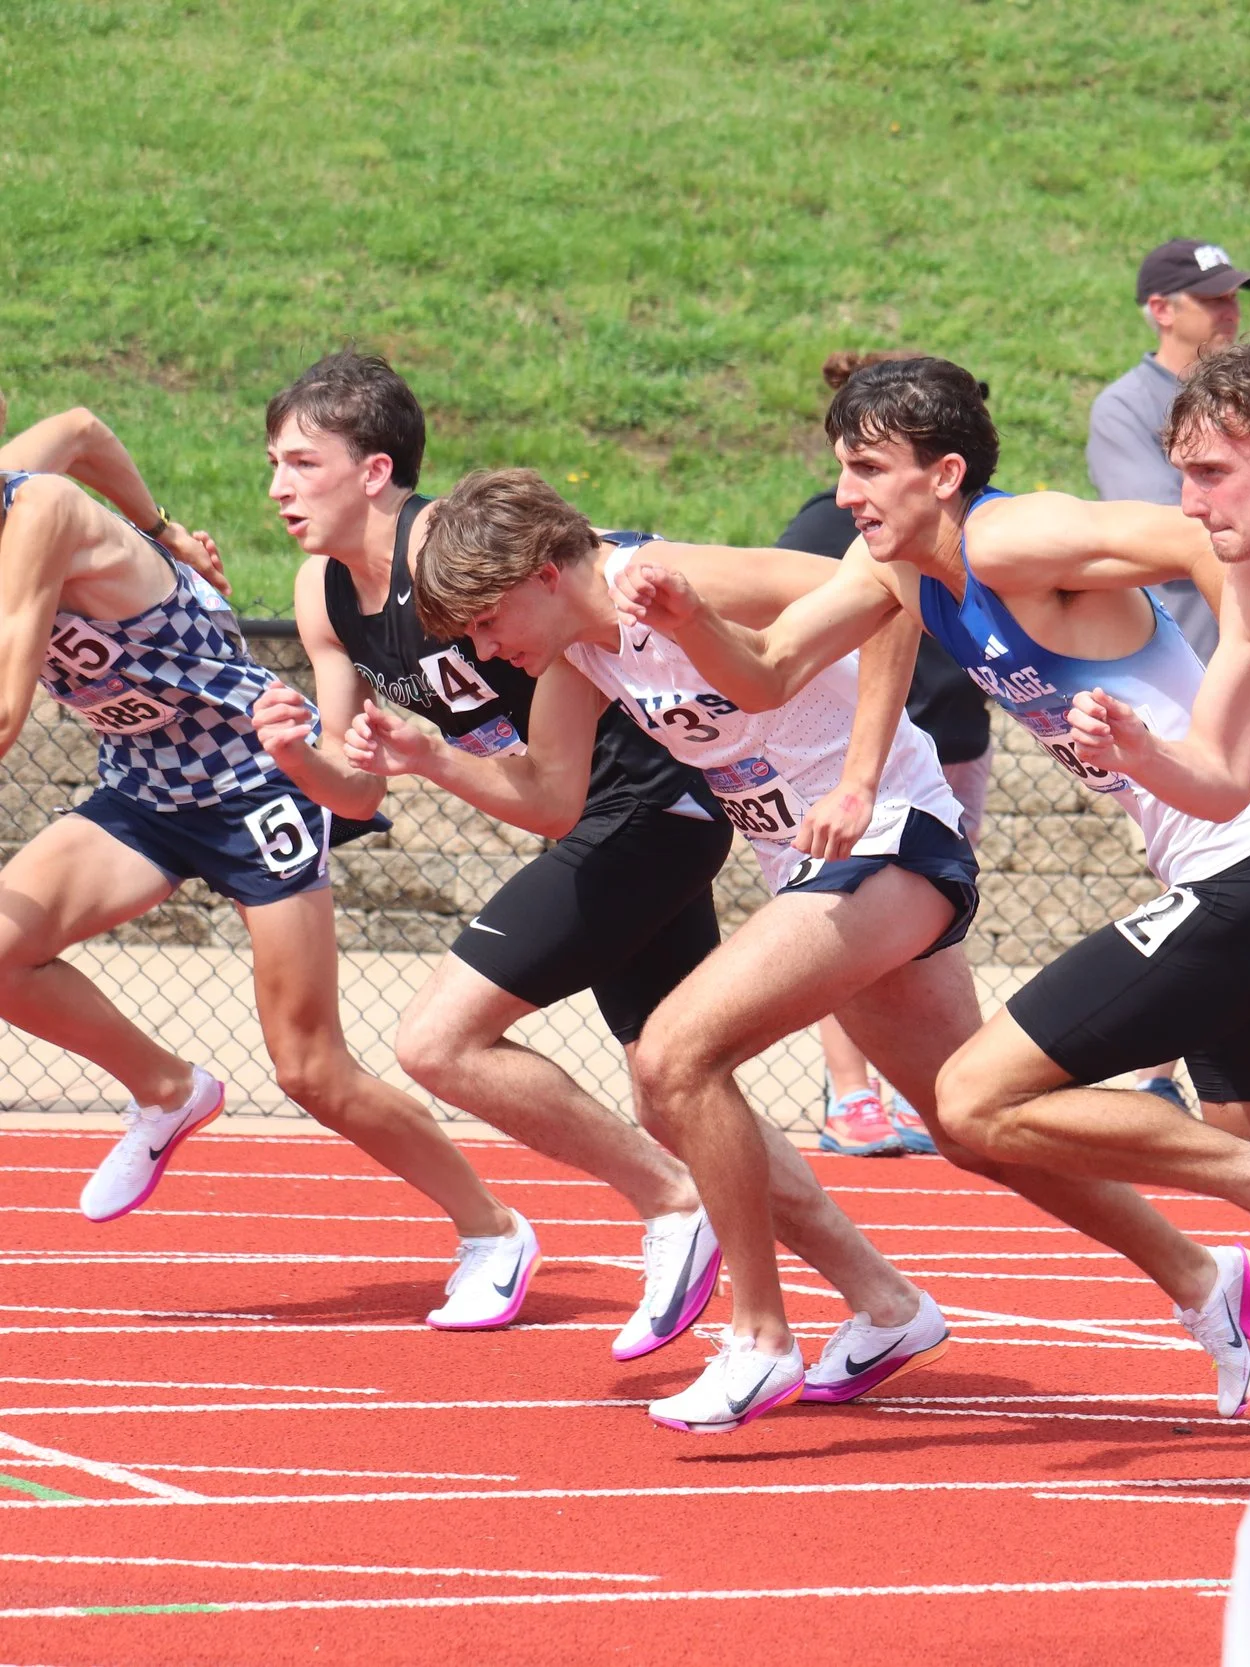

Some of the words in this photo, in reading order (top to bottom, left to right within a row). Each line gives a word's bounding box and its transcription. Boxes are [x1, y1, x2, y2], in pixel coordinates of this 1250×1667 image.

[51, 626, 110, 671] 5
[437, 656, 486, 702] 4
[662, 707, 720, 743] 3
[258, 803, 303, 863] 5
[1123, 892, 1184, 946] 2
